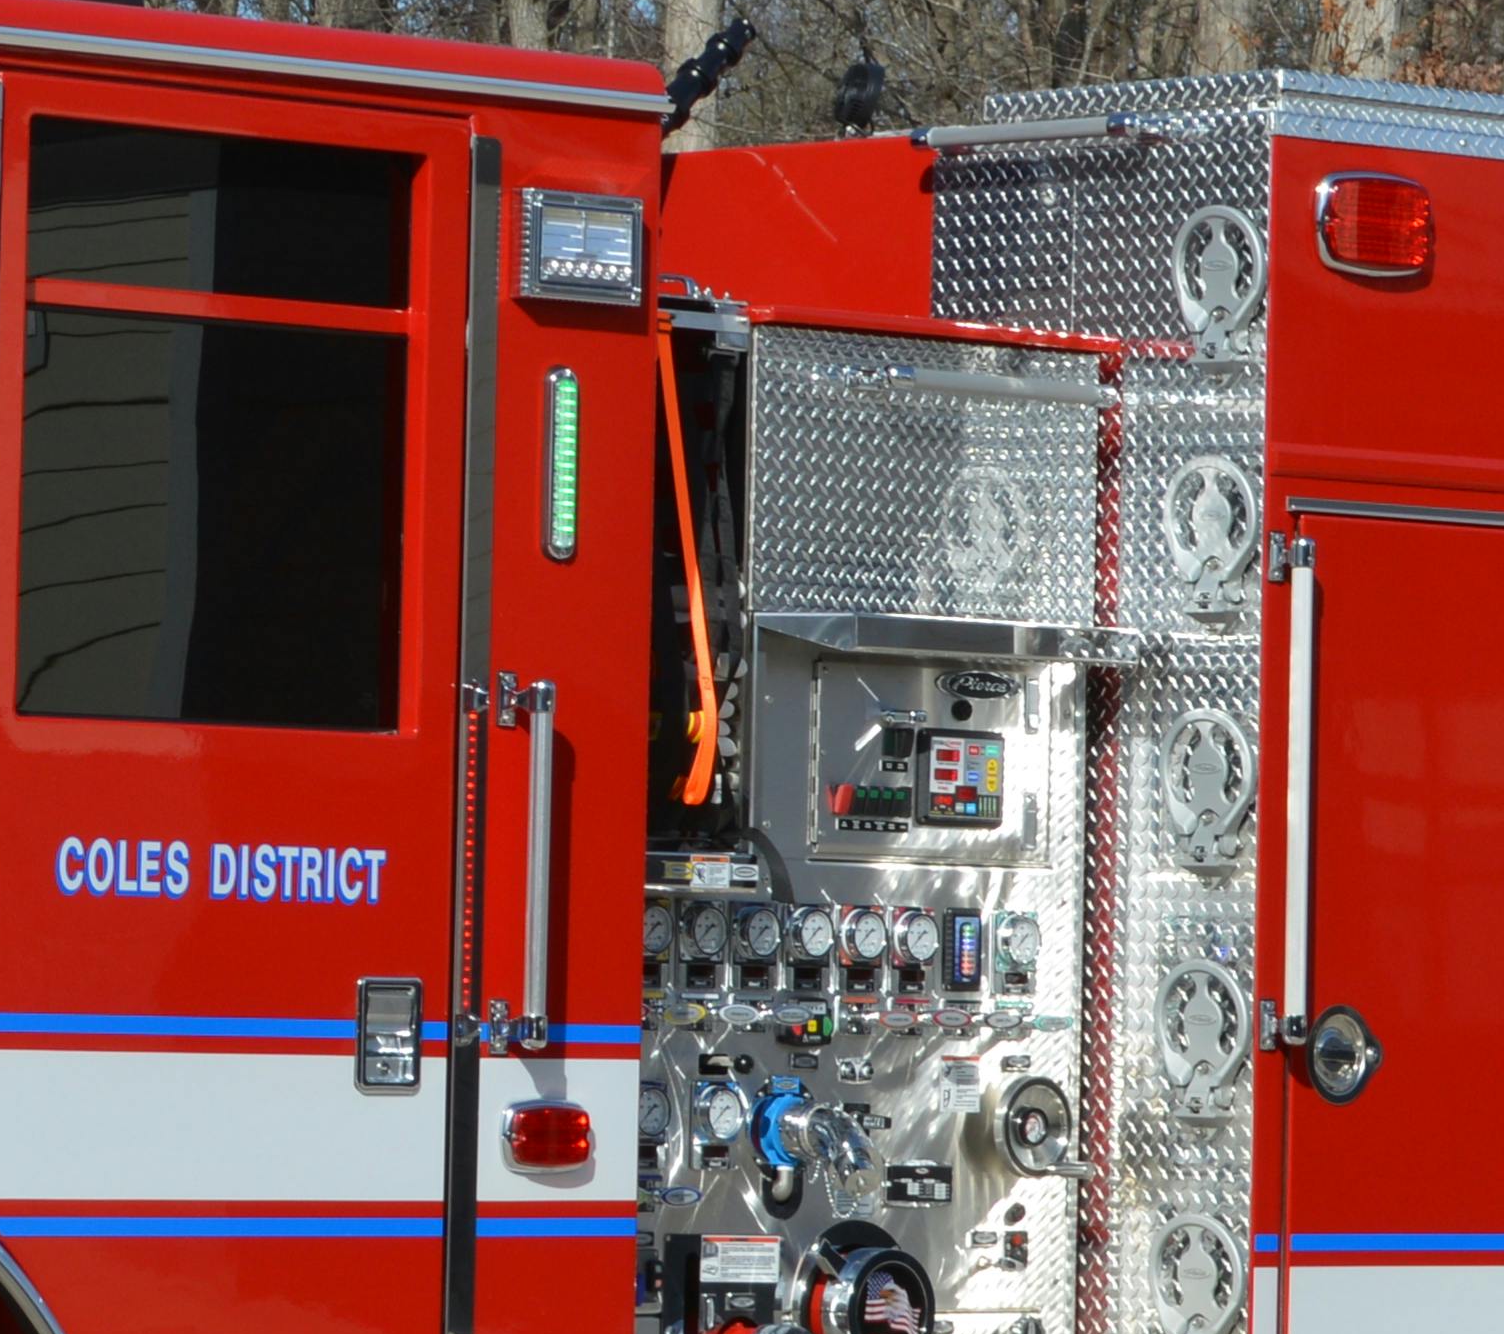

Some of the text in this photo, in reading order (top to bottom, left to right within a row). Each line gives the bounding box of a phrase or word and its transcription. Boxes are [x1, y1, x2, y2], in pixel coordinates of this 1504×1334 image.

[954, 673, 1008, 695] Pierce
[55, 836, 386, 905] COLES DISTRICT
